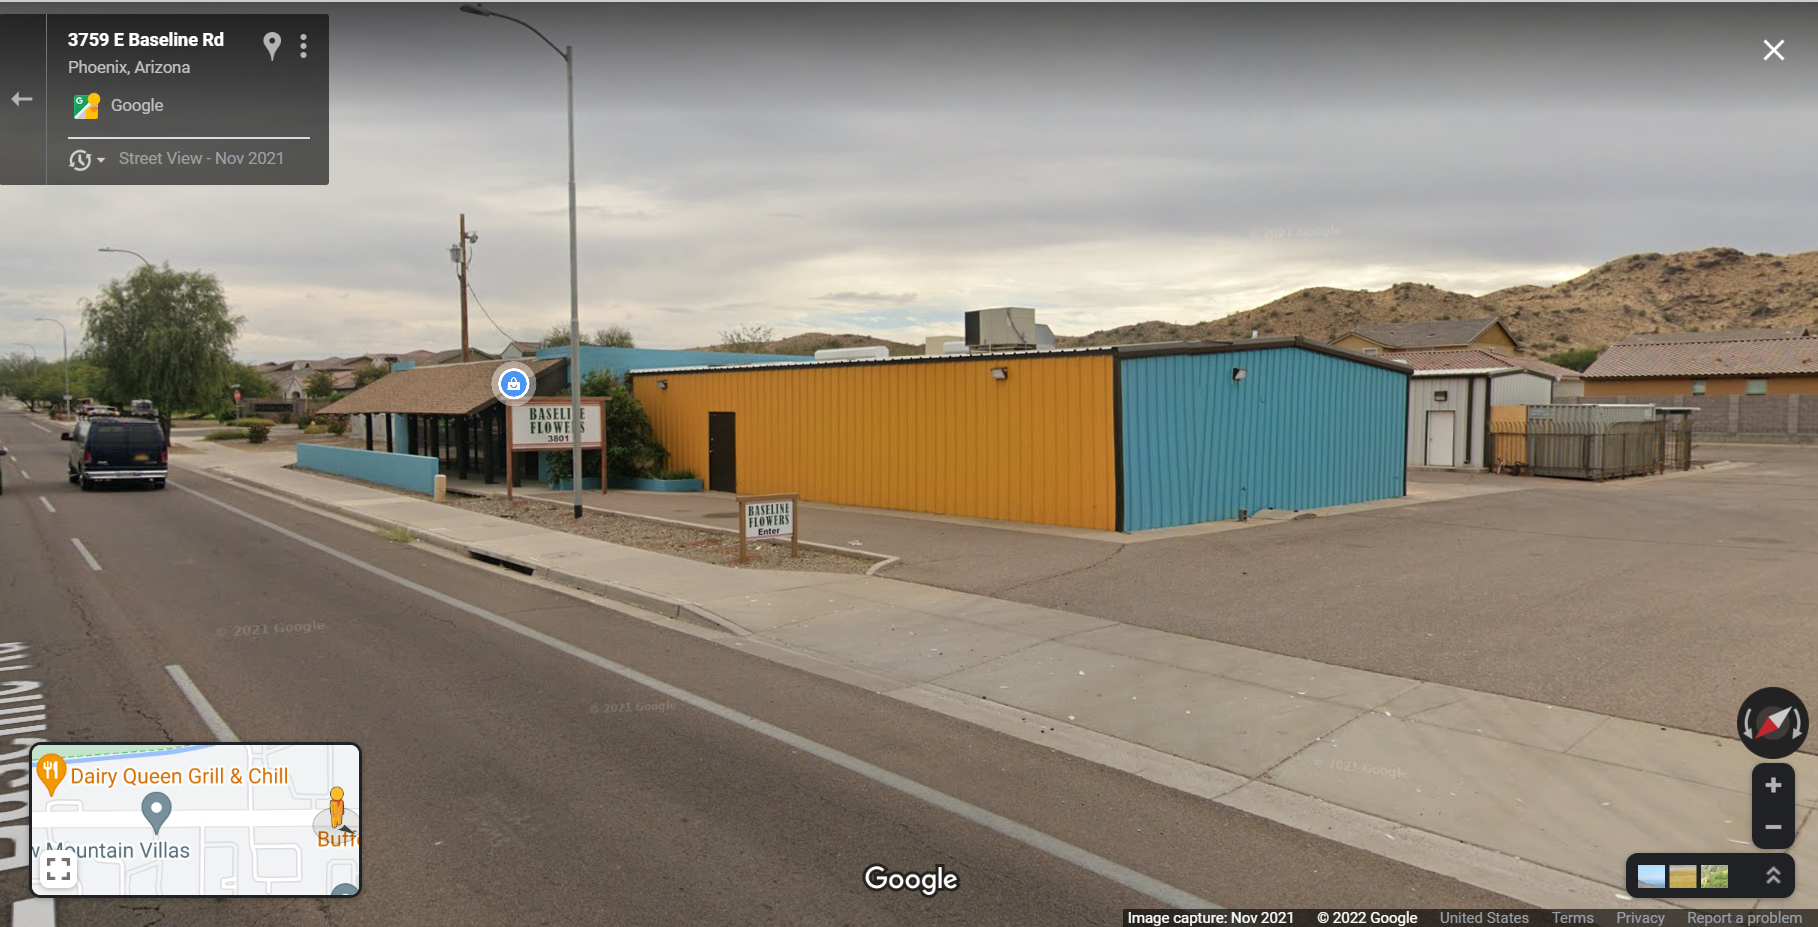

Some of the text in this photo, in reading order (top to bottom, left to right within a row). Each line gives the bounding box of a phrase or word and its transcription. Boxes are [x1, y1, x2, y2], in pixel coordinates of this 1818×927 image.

[529, 407, 586, 421] BASELIE
[530, 420, 586, 434] FLOWES
[548, 434, 570, 443] 3801
[748, 503, 790, 517] BASELINE
[748, 514, 790, 529] FLOWERS
[758, 528, 780, 536] Enter
